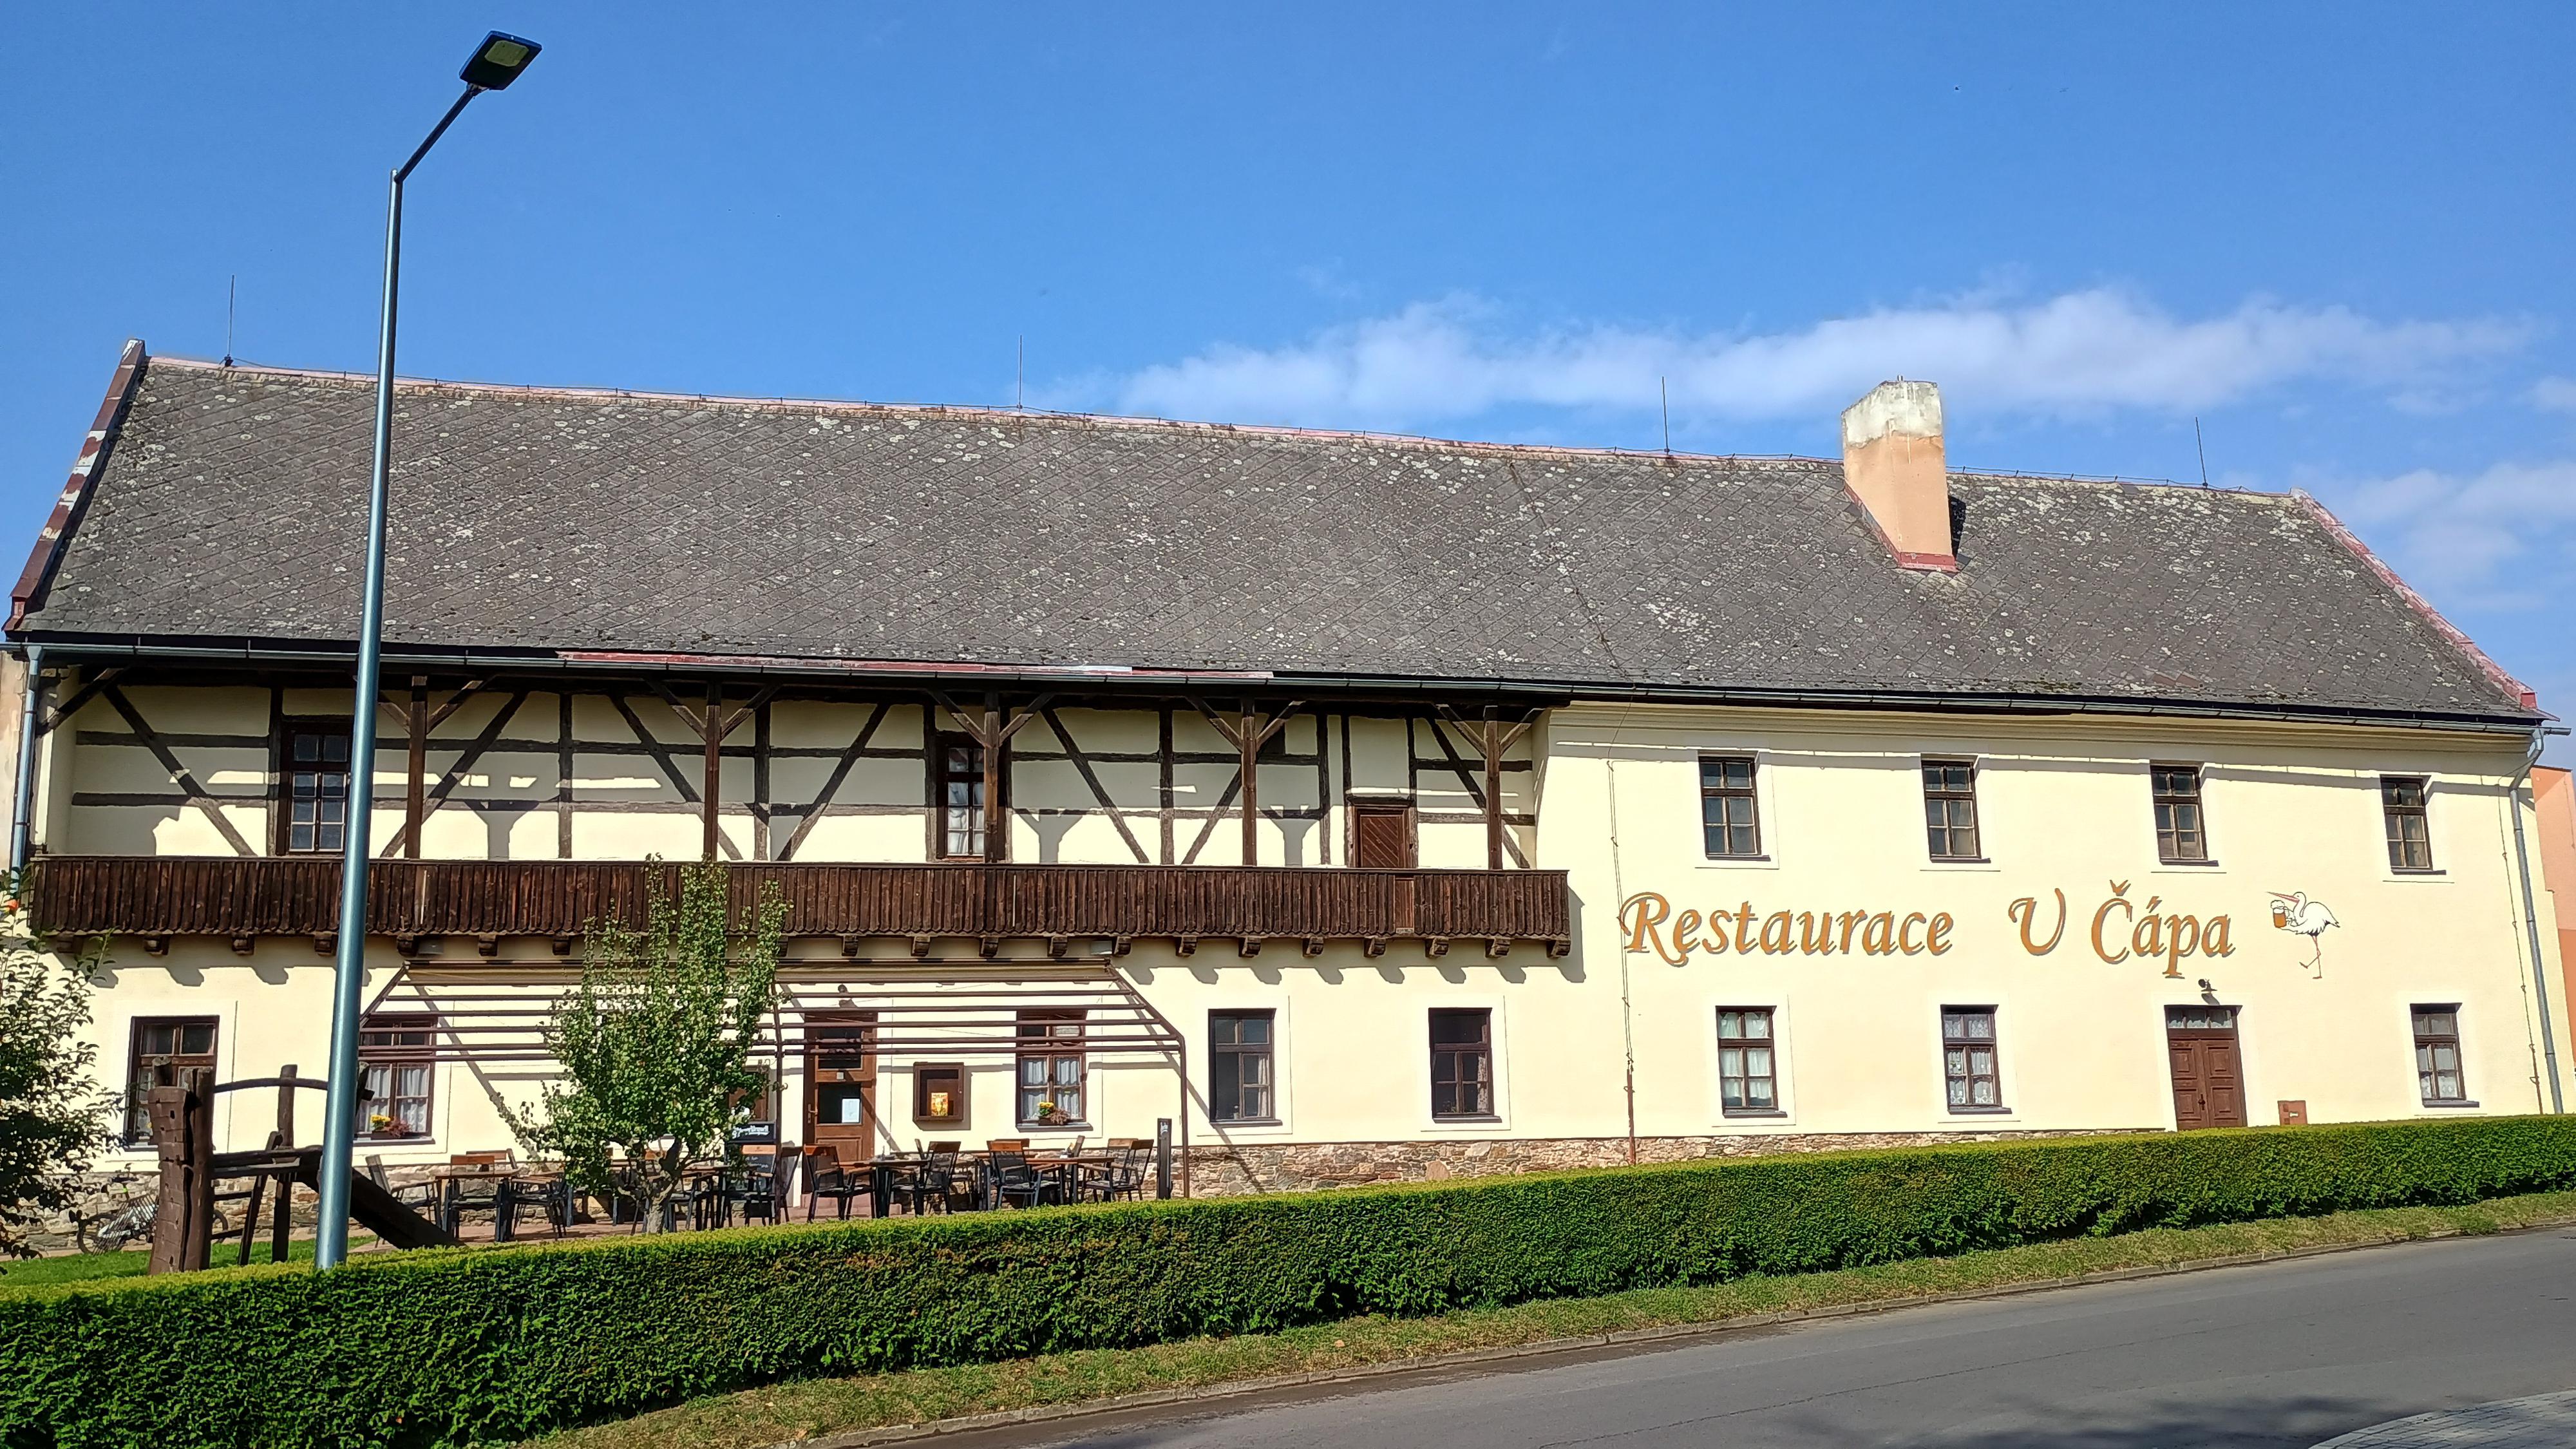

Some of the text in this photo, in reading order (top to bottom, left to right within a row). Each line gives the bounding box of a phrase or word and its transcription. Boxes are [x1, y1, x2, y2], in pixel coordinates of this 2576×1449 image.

[1620, 878, 2237, 979] Restaurace U Čápa
